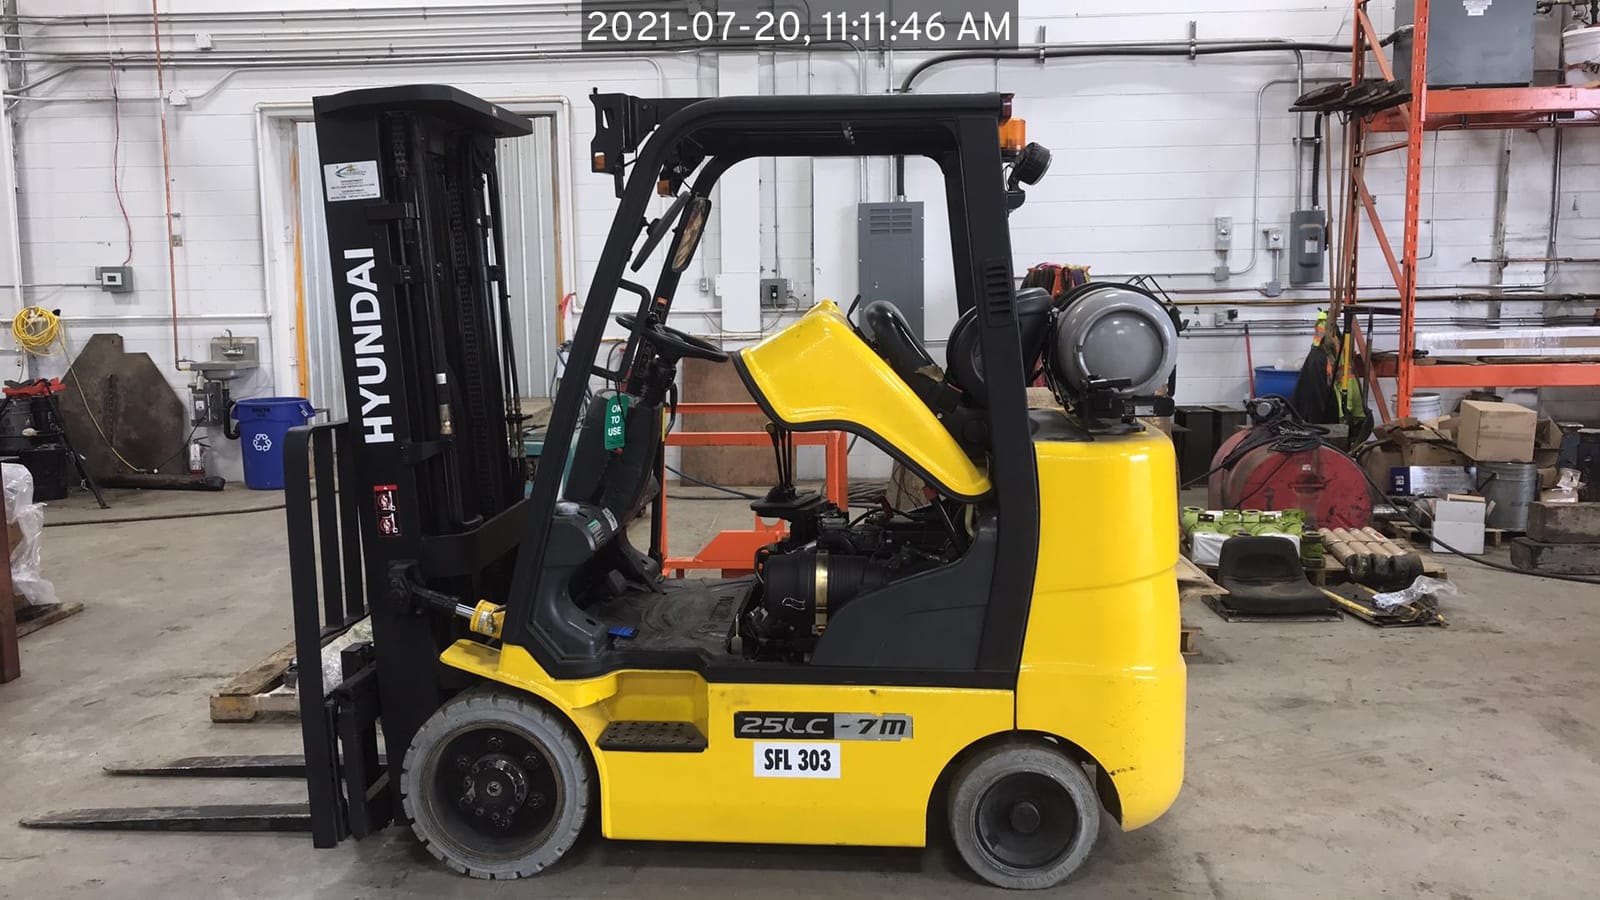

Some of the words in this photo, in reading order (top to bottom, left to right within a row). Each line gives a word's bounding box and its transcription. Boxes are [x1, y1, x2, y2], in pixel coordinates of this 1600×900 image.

[344, 247, 395, 443] HYUNDAI
[611, 415, 621, 424] TO
[608, 426, 622, 436] USE
[764, 748, 793, 771] SFL
[798, 749, 832, 772] 303
